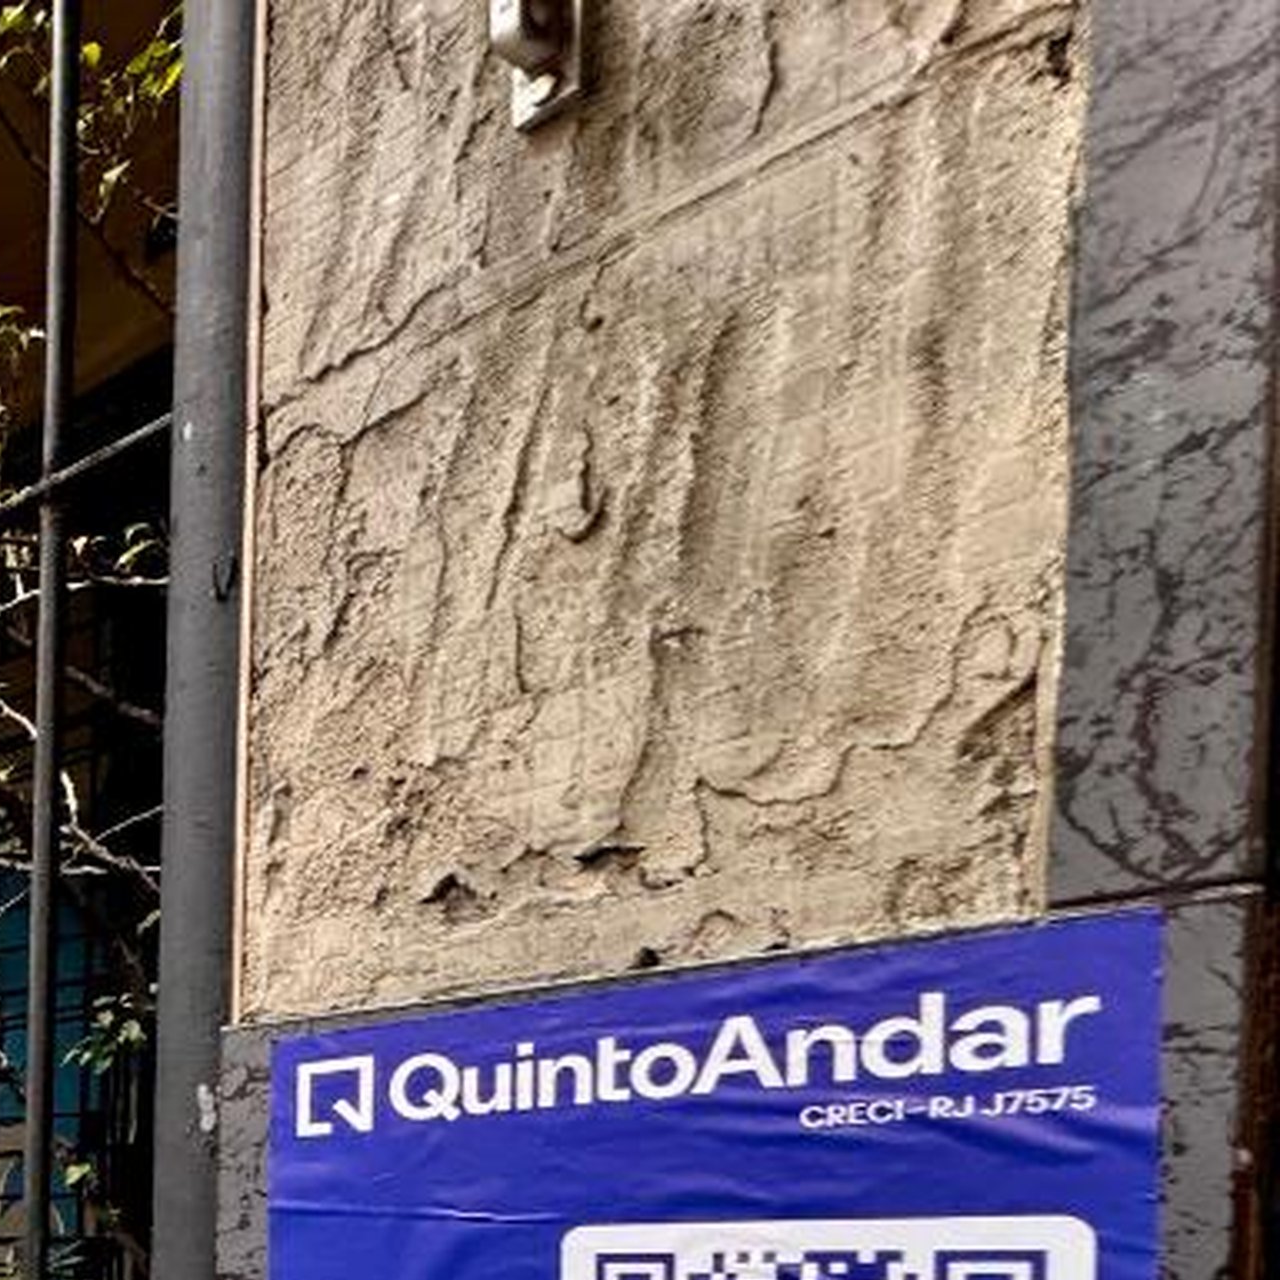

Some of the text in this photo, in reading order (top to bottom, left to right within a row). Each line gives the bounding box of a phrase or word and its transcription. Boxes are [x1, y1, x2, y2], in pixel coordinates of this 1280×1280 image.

[388, 993, 1102, 1124] QuintoAndar
[798, 1085, 1097, 1128] CRECI-RJ J7575
